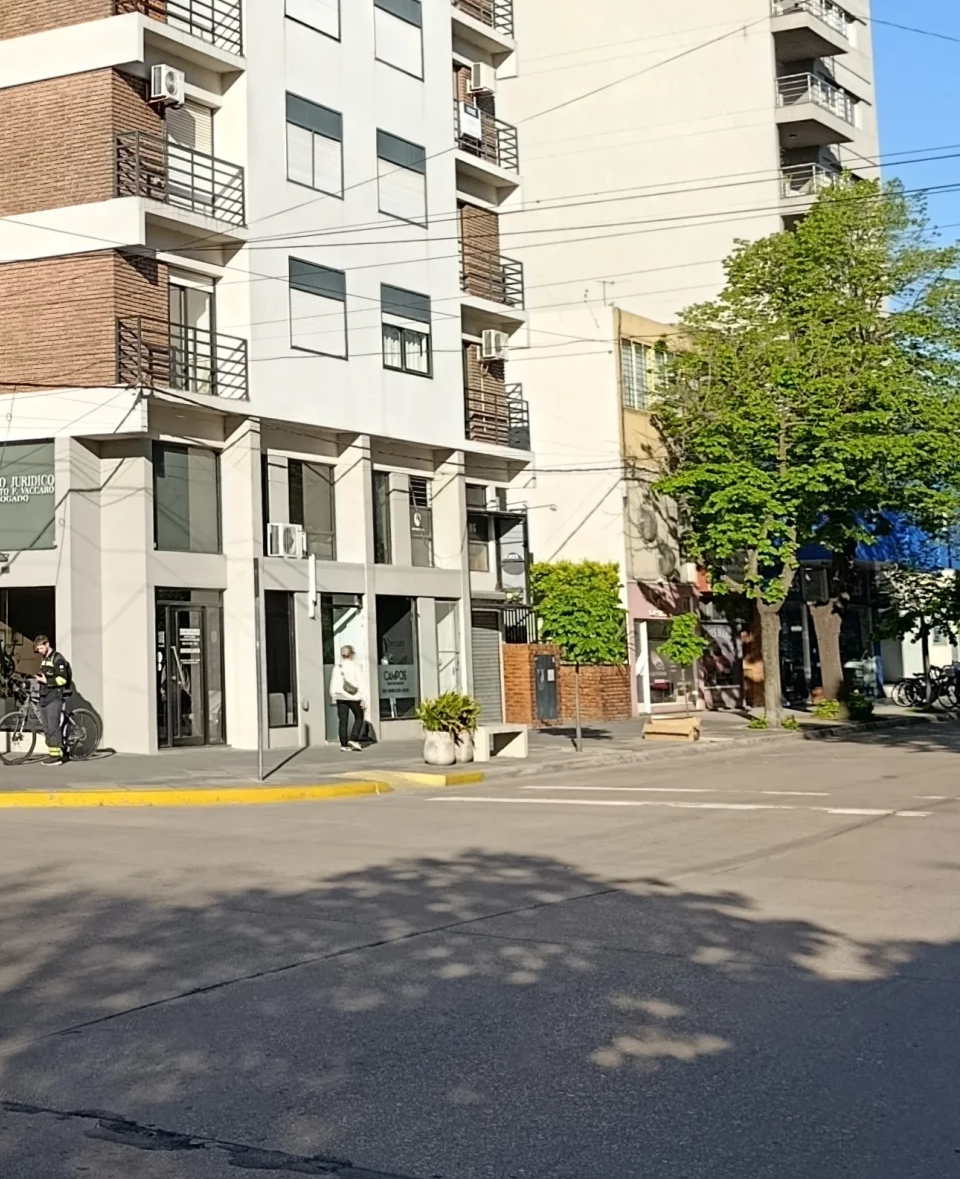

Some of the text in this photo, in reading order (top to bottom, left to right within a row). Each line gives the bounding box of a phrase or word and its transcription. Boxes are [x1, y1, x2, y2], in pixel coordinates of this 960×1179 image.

[10, 474, 55, 487] JURIDICO
[20, 486, 55, 495] VACCARO
[383, 670, 407, 681] CAMPOS
